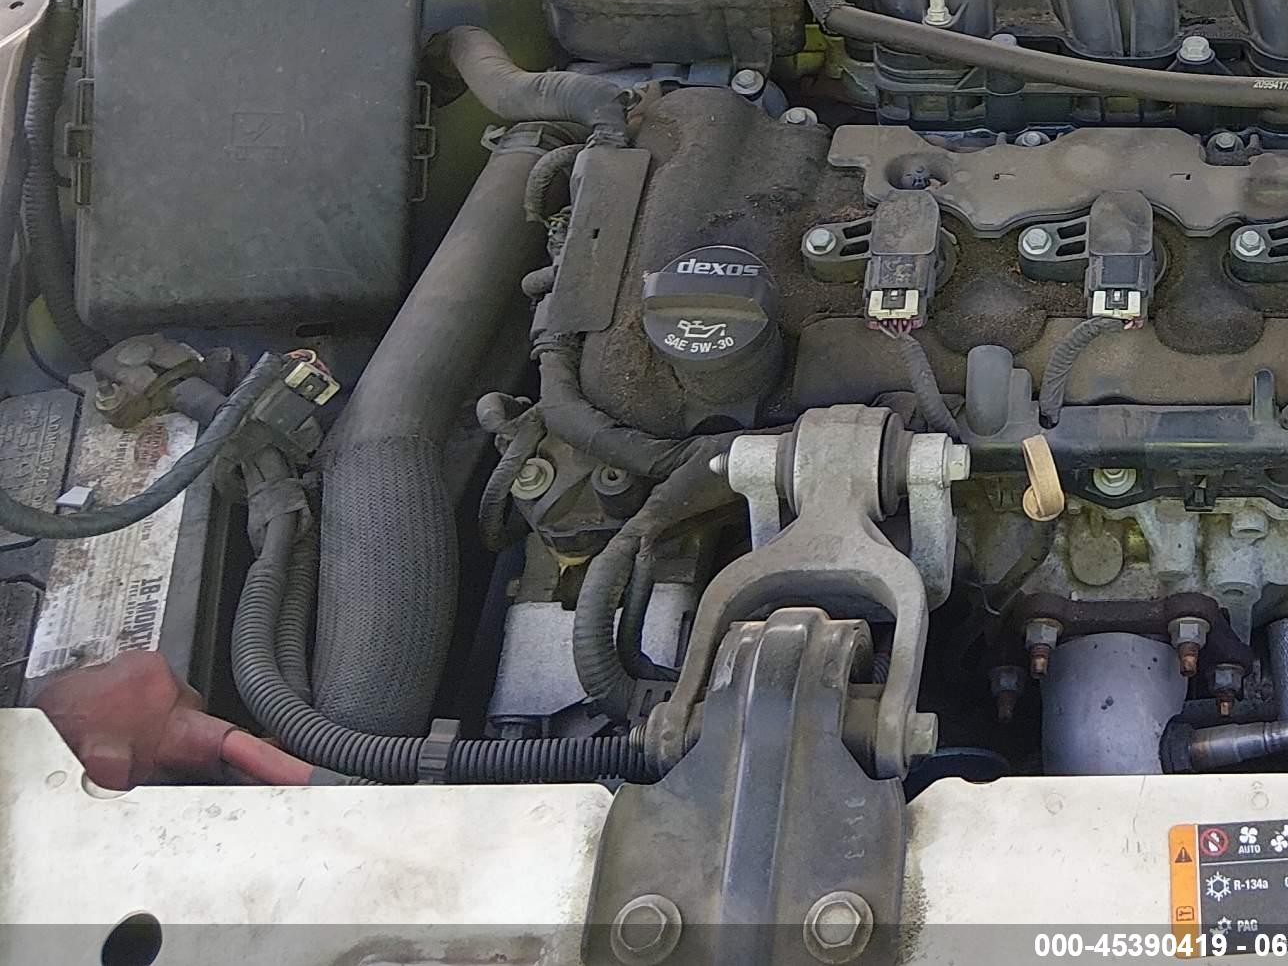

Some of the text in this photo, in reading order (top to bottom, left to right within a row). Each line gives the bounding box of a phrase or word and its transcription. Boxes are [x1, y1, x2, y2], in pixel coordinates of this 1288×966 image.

[677, 259, 764, 276] dexos
[664, 334, 735, 354] SAE 5W-30
[1238, 844, 1262, 854] AUTO
[1233, 879, 1269, 891] R-134a
[1237, 919, 1259, 932] PAG
